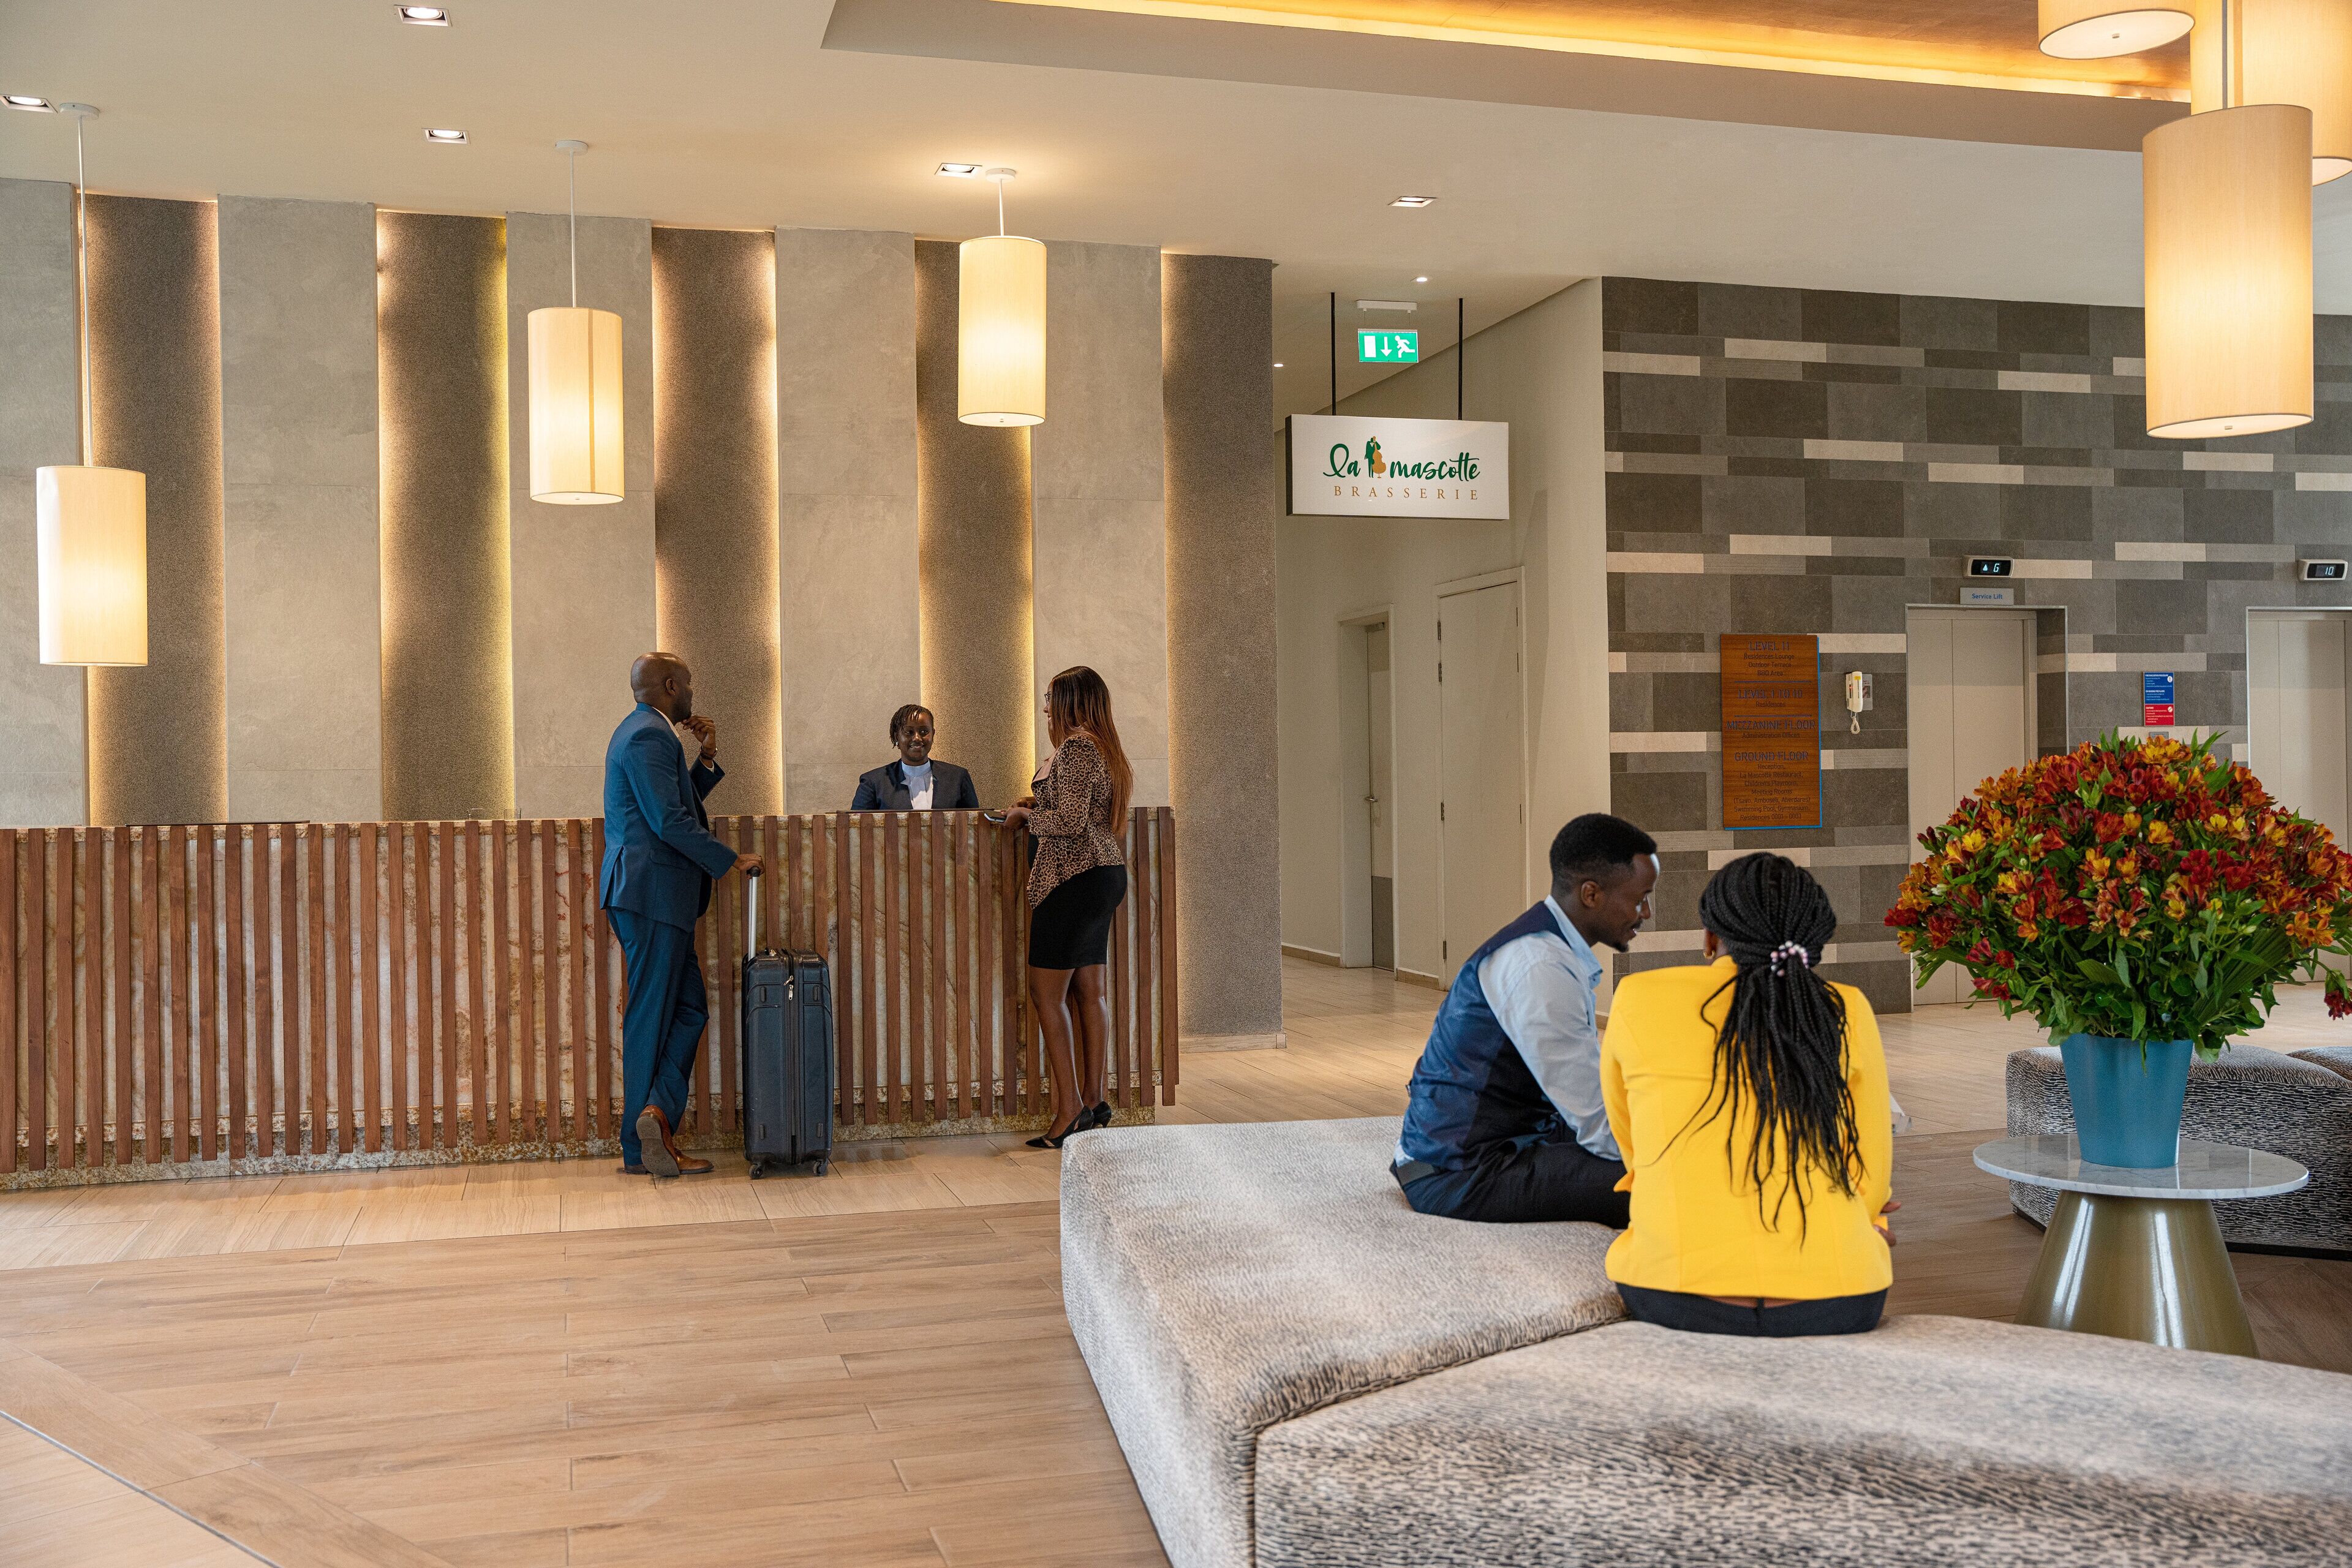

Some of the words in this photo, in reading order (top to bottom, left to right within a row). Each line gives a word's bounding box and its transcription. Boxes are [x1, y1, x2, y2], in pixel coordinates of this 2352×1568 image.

[1323, 443, 1361, 478] la
[1390, 451, 1481, 481] mascotte
[1333, 485, 1479, 500] BRASSERIE
[2325, 566, 2334, 575] 10
[1749, 641, 1779, 651] LEVEL
[1738, 689, 1767, 699] LEVEL
[1779, 689, 1790, 698] TO
[1793, 689, 1803, 698] 10
[1727, 720, 1782, 730] MEZZANINE
[1784, 720, 1815, 729] FLOOR
[1734, 752, 1775, 761] GROUND
[1777, 751, 1809, 761] FLOOR
